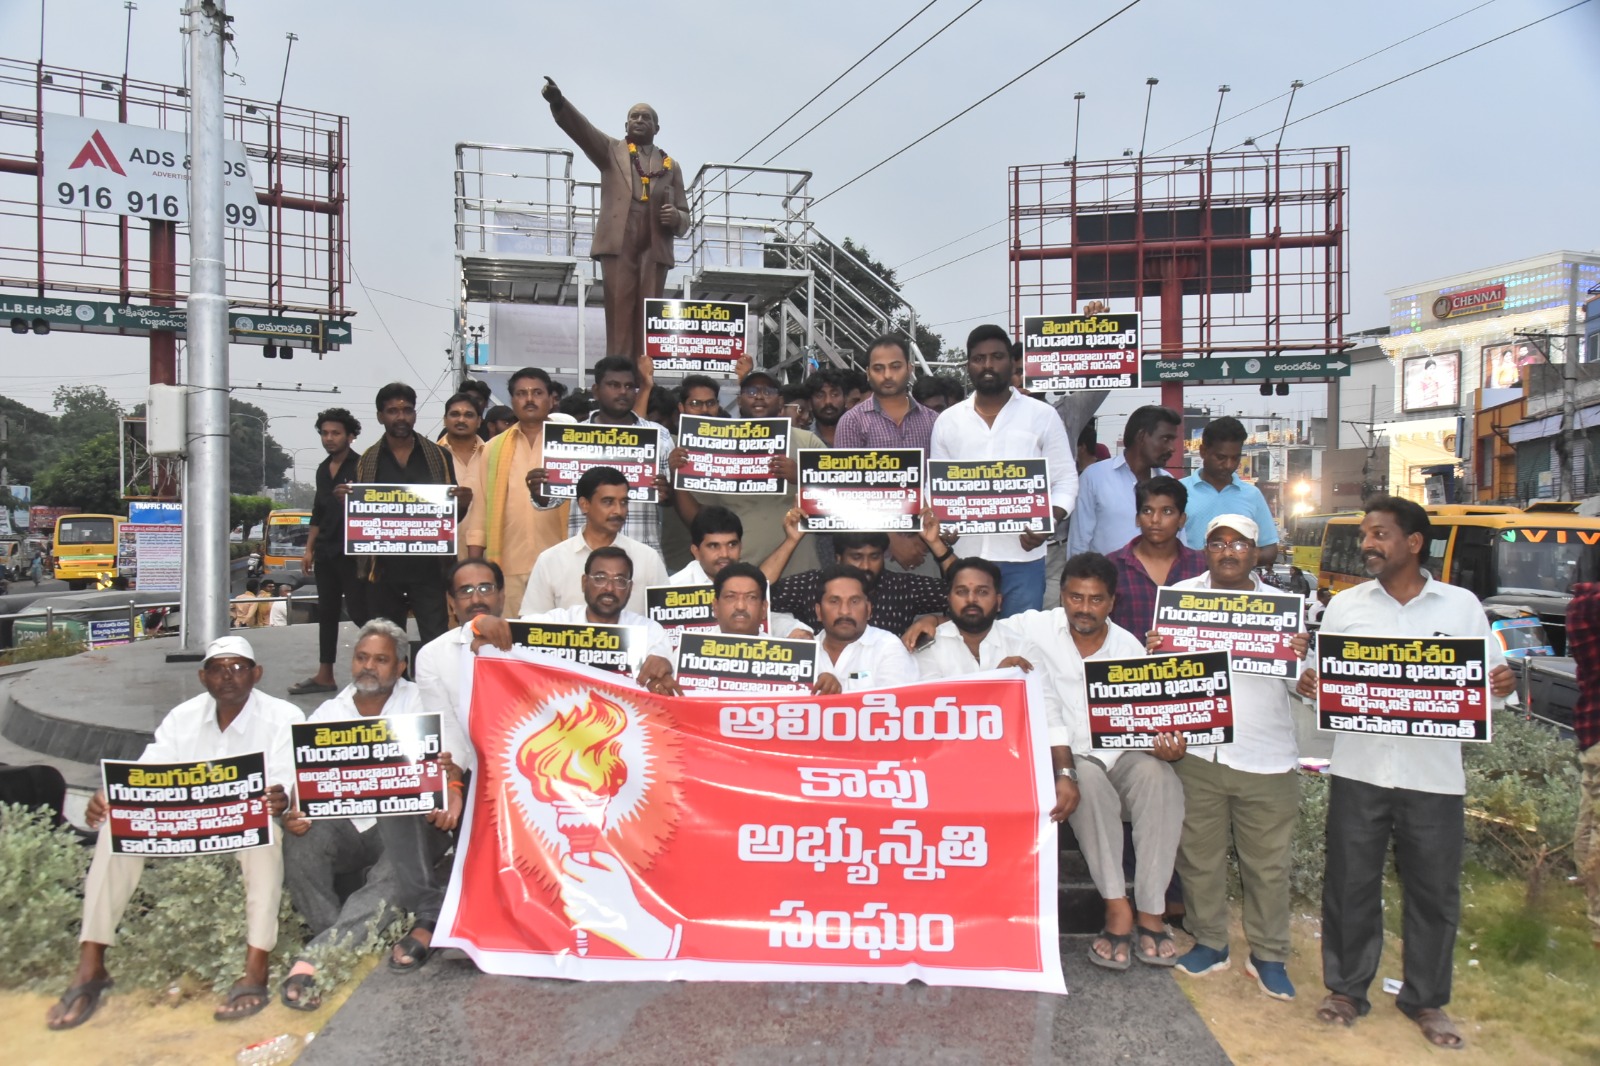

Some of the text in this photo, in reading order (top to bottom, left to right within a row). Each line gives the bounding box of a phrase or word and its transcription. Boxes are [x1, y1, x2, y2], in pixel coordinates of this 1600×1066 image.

[129, 148, 175, 168] ADS
[224, 160, 246, 178] DS
[58, 182, 112, 209] 916
[128, 191, 178, 217] 916
[1453, 291, 1502, 307] CHENNAI
[257, 322, 303, 334] అమరావతి
[648, 317, 697, 331] గుండాలు
[1042, 317, 1118, 335] తెలుగుదేశం
[648, 335, 676, 344] అంబటి
[678, 338, 714, 346] రాంబాబు
[1027, 334, 1082, 347] గుండాలు
[703, 346, 730, 355] నిరసన
[1027, 352, 1059, 362] అంబటి
[1060, 353, 1103, 362] రాంబాబు
[1104, 352, 1124, 360] గారి
[1090, 360, 1121, 370] నిరసన
[1089, 374, 1131, 388] యూత్
[561, 429, 638, 446] తెలుగుదేశం
[696, 422, 769, 438] తెలుగుదేశం
[682, 433, 734, 450] గుండాలు
[546, 459, 578, 469] అంబటి
[622, 465, 642, 473] గారి
[712, 456, 752, 465] రాంబాబు
[818, 452, 900, 470] తెలుగుదేశం
[802, 469, 862, 483] గుండాలు
[947, 462, 1026, 479] తెలుగుదేశం
[684, 478, 778, 492] కారసాని యూత్
[932, 478, 991, 491] గుండాలు
[350, 501, 403, 514] గుండాలు
[933, 496, 967, 505] అంబటి
[1013, 496, 1034, 504] గారి
[1000, 504, 1032, 514] నిరసన
[349, 518, 380, 527] అంబటి
[409, 528, 438, 536] నిరసన
[354, 540, 448, 553] కారసాని యూత్
[1178, 595, 1274, 614] తెలుగుదేశం
[1159, 607, 1227, 624] గుండాలు
[528, 628, 620, 649] తెలుగుదేశం
[1157, 628, 1279, 644] అంబటి రాంబాబు గారి
[700, 639, 792, 662] తెలుగుదేశం
[1234, 643, 1274, 654] నిరసన
[1342, 640, 1454, 663] తెలుగుదేశం
[681, 653, 748, 672] గుండాలు
[1108, 658, 1204, 682] తెలుగుదేశం
[1231, 659, 1287, 675] యూత్
[1322, 656, 1402, 678] గుండాలు
[679, 676, 718, 688] అంబటి
[1090, 681, 1161, 697] గుండాలు
[1322, 682, 1368, 695] అంబటి
[1370, 686, 1432, 699] రాంబాబు
[1434, 689, 1464, 700] గారి
[1092, 703, 1133, 715] అంబటి
[1134, 703, 1188, 714] రాంబాబు
[1189, 700, 1214, 711] గారి
[1413, 700, 1459, 713] నిరసన
[719, 693, 1003, 741] ఆలిండియా
[1172, 710, 1210, 724] నిరసన
[1329, 715, 1475, 737] కారసాని యూత్
[297, 746, 369, 763] గుండాలు
[129, 763, 237, 786] తెలుగుదేశం
[299, 768, 340, 782] అంబటి
[341, 768, 396, 780] రాంబాబు
[380, 777, 419, 790] నిరసన
[797, 761, 928, 808] కాపు
[110, 784, 188, 802] గుండాలు
[112, 808, 156, 820] అంబటి
[158, 808, 217, 820] రాంబాబు
[219, 803, 247, 816] గారి
[307, 793, 433, 815] కారసాని యూత్
[200, 814, 243, 830] నిరసన
[121, 829, 259, 854] కారసాని యూత్
[738, 817, 988, 884] అభ్యున్నతి
[768, 900, 954, 959] సంఘం
